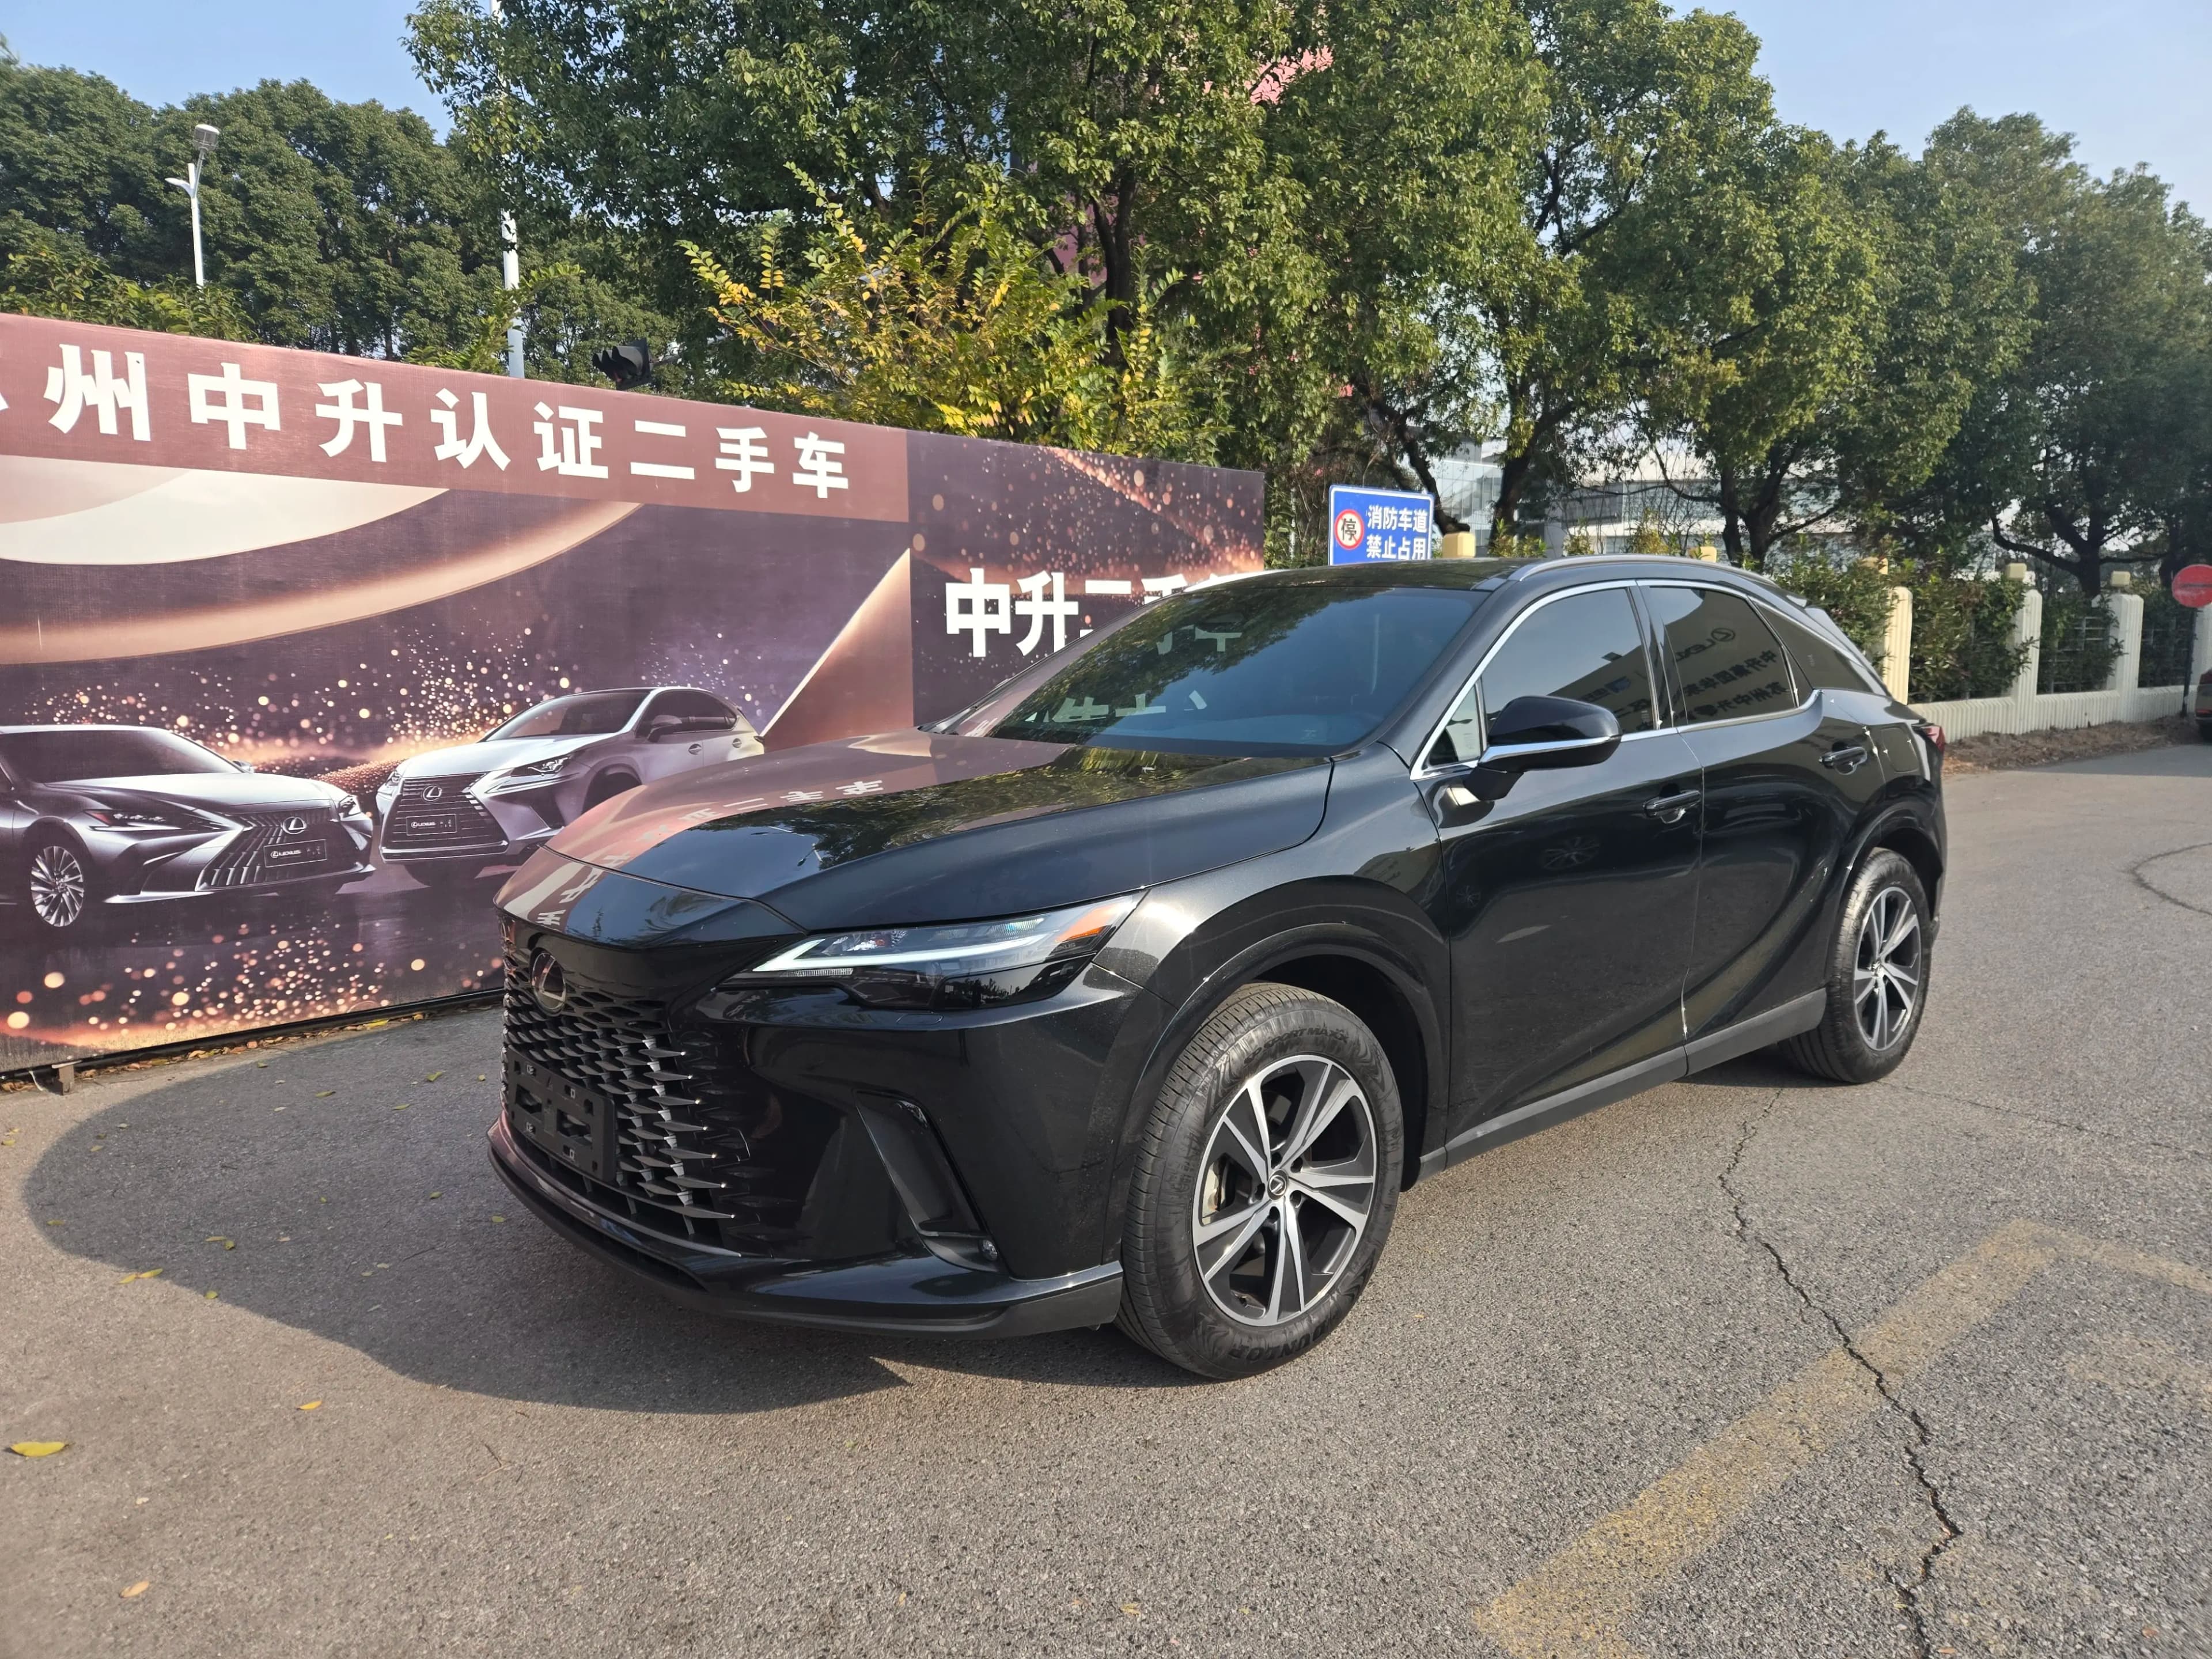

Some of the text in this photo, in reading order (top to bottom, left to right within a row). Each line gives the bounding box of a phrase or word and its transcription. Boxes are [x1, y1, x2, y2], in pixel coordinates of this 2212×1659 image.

[0, 344, 849, 499] 州中升认证二手车
[1341, 518, 1357, 541] 停
[1367, 504, 1428, 533] 消防车道
[1366, 533, 1427, 560] 禁止占用
[1228, 1320, 1328, 1361] DUNLOP
